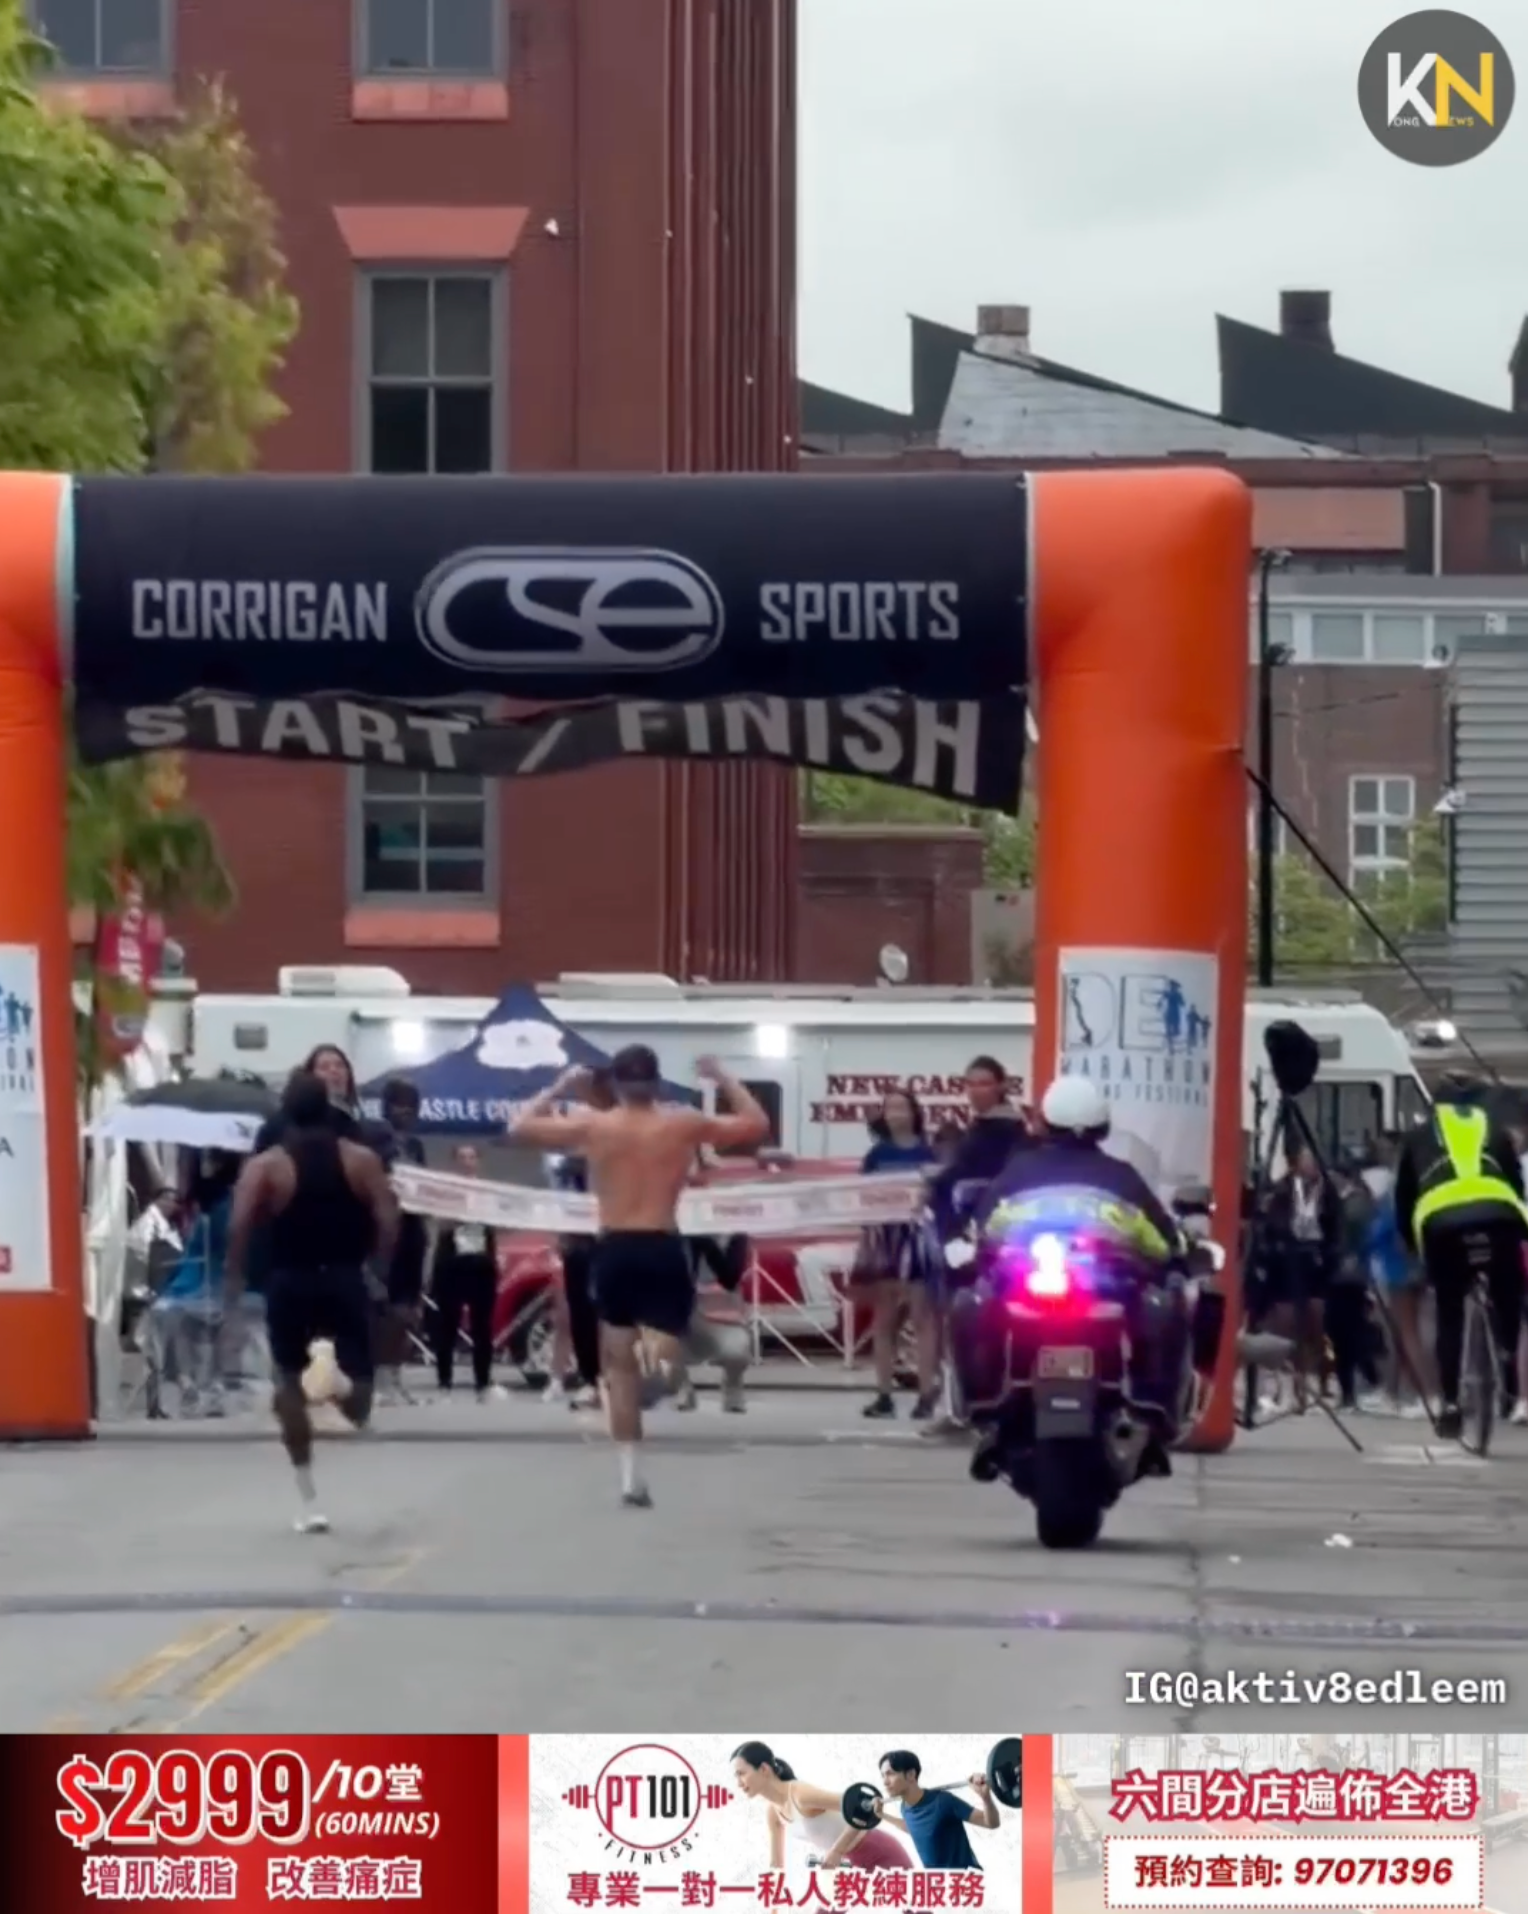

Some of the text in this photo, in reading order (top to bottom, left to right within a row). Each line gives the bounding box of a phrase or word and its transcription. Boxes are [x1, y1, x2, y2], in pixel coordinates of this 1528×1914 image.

[132, 579, 388, 642] CORRIGAN
[760, 581, 960, 641] SPORTS
[125, 695, 471, 769] START
[616, 692, 981, 797] FINISH
[418, 1097, 479, 1122] ASTLE
